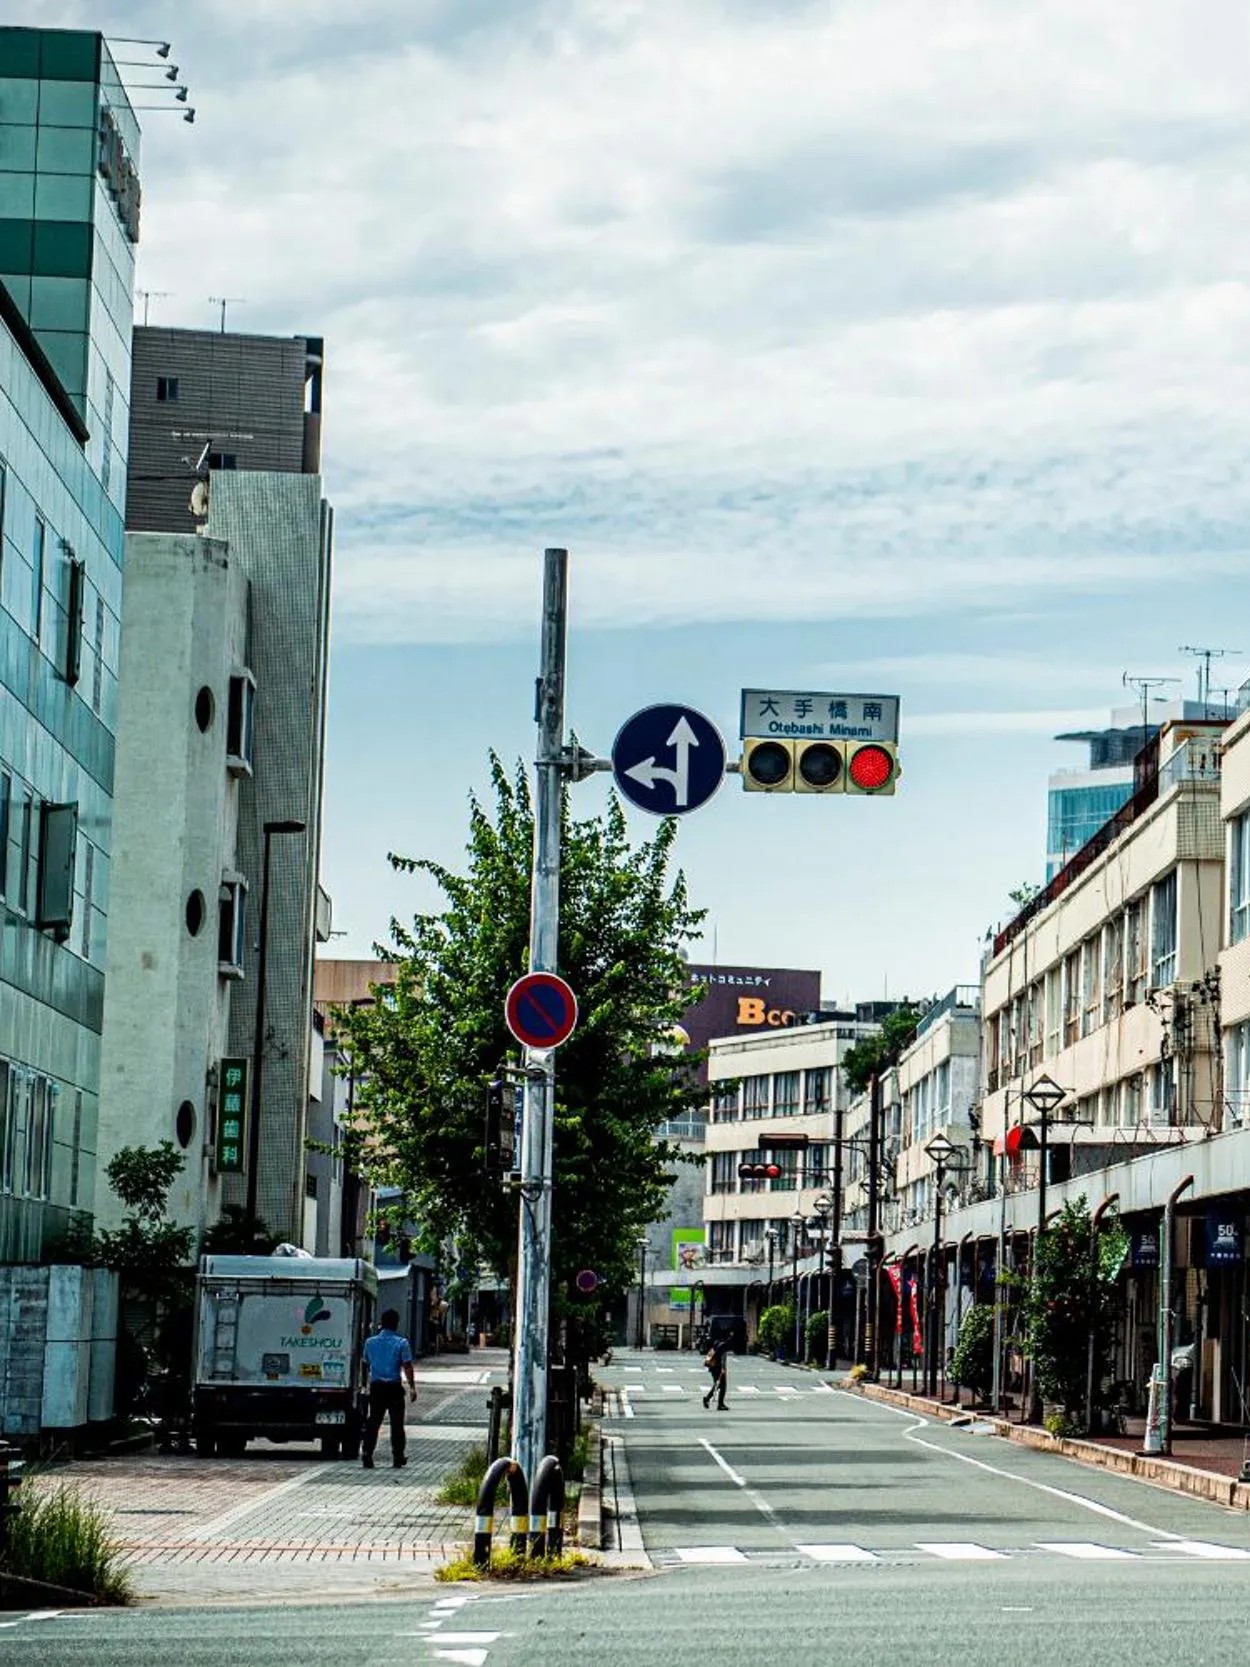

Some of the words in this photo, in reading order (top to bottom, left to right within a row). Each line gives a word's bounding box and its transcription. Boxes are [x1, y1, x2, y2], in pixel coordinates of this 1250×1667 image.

[759, 698, 882, 721] 大手橋南
[768, 721, 824, 736] Otebashi
[829, 723, 872, 737] Minami
[279, 1335, 343, 1349] TAKESHOU
